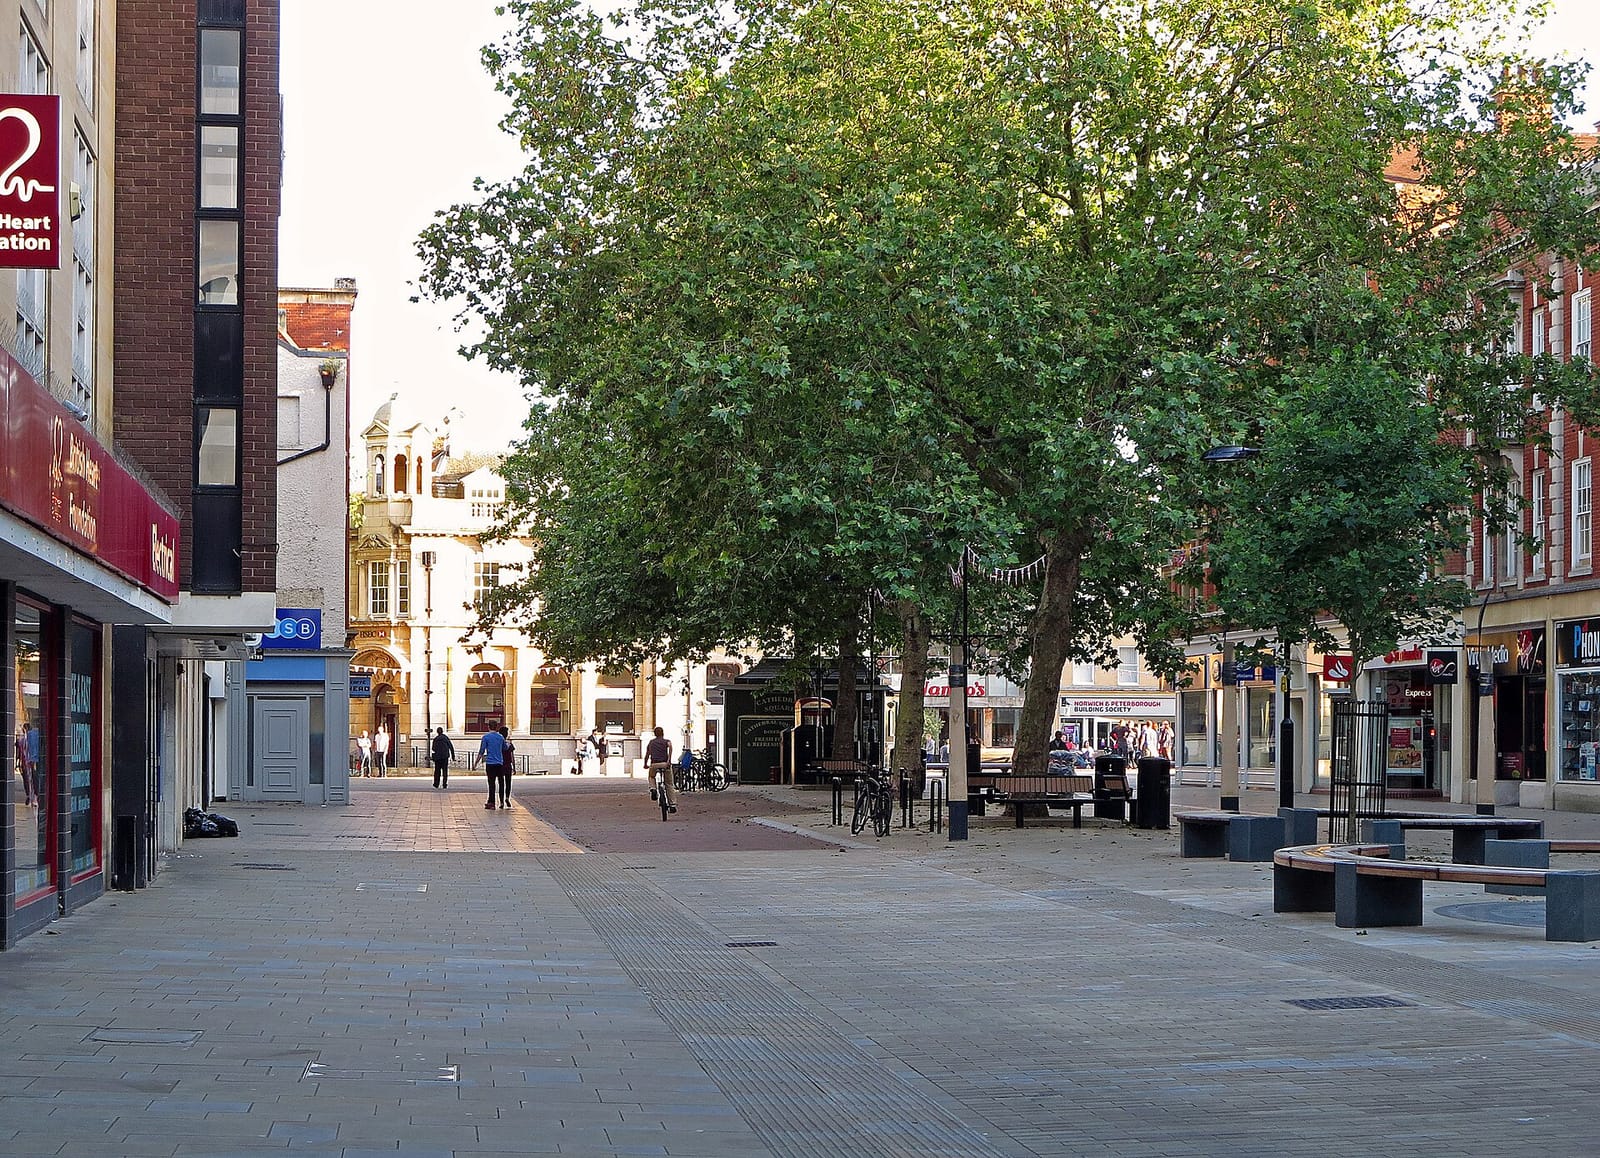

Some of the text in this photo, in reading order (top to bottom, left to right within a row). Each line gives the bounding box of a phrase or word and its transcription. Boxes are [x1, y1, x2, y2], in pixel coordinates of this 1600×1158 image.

[0, 213, 51, 230] Heart
[0, 232, 51, 250] ation
[69, 492, 97, 543] Foundation
[152, 523, 175, 584] Electrical
[924, 681, 985, 696] ano's
[1405, 689, 1432, 698] Express
